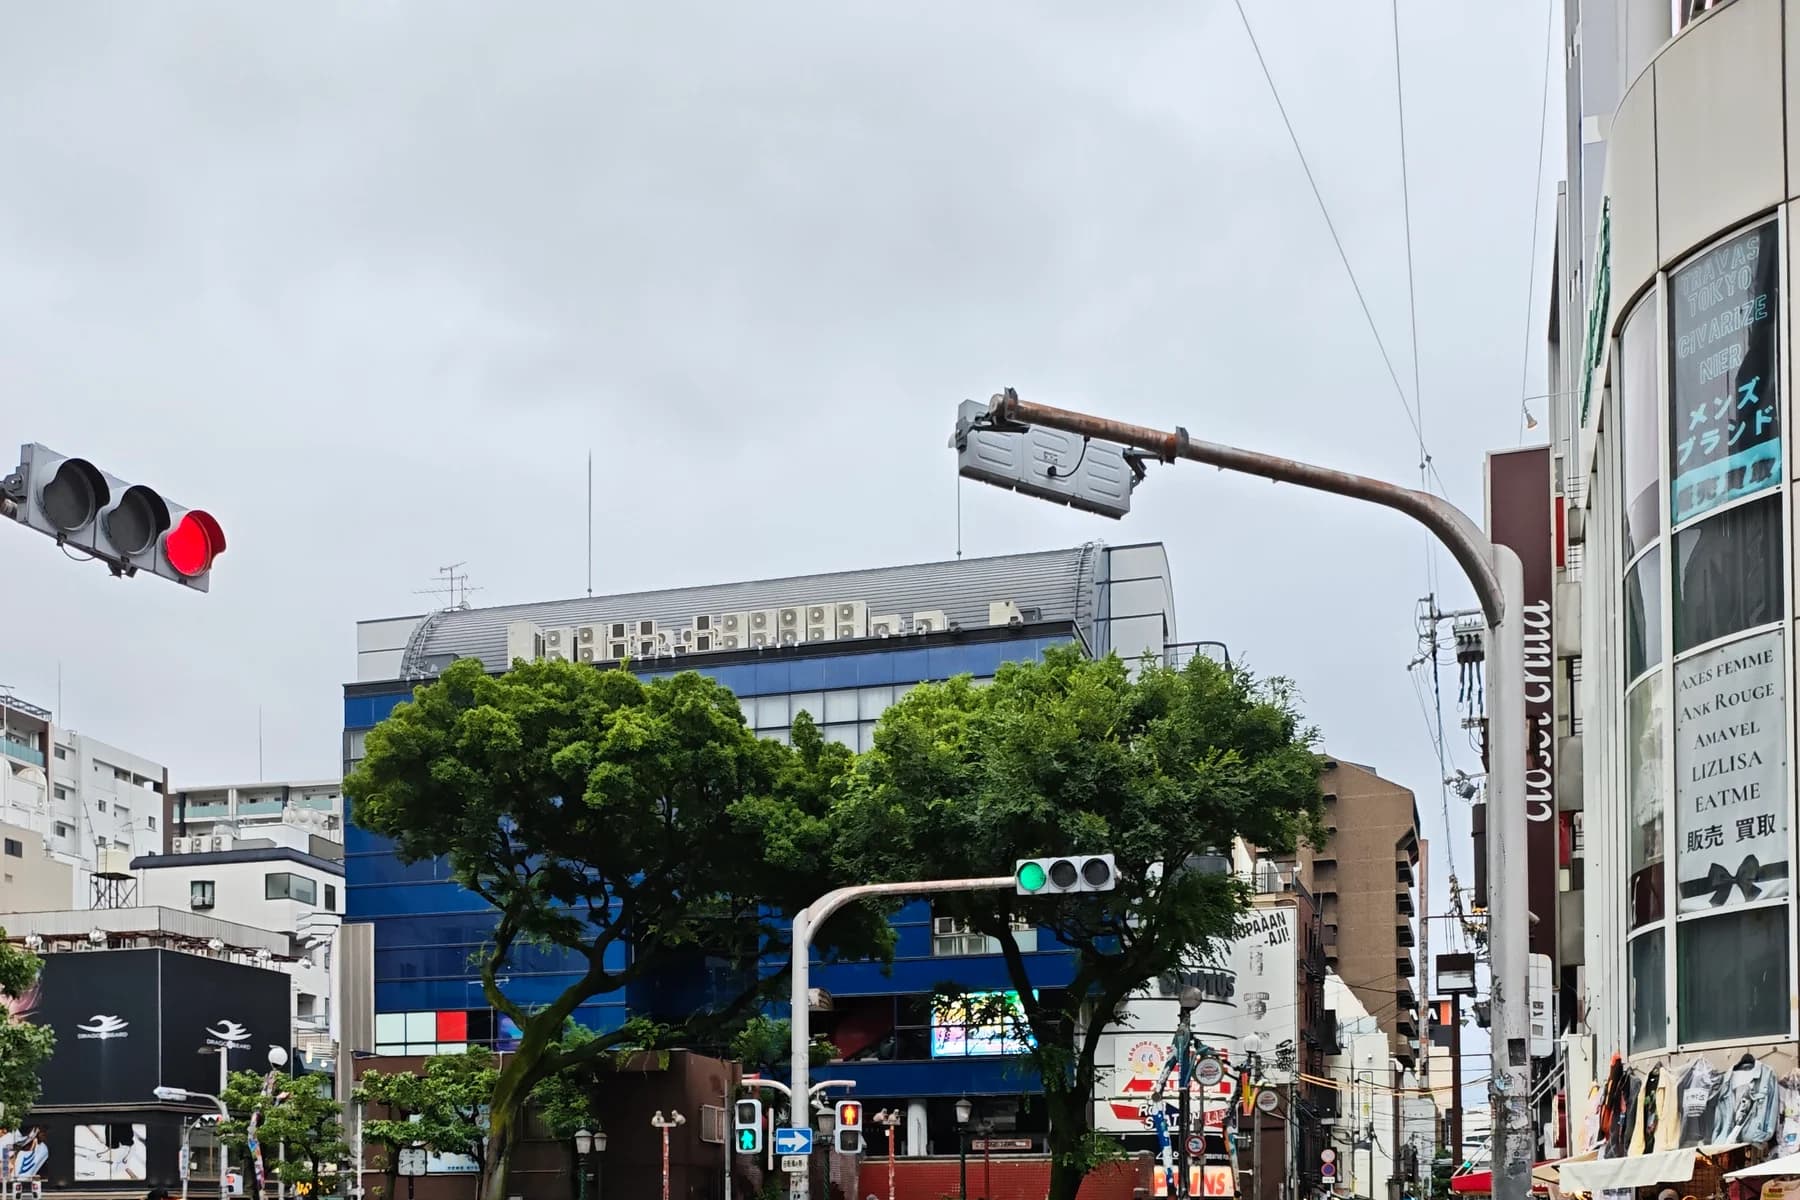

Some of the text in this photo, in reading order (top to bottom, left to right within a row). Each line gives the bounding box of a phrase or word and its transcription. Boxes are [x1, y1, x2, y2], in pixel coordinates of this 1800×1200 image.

[1681, 235, 1760, 297] TRAVAS
[1687, 265, 1752, 318] TOKYO
[1678, 294, 1768, 359] CIVARIZE
[1700, 343, 1742, 385] NIER
[1688, 375, 1761, 431] メンズ
[1678, 405, 1774, 466] ブランド
[1680, 649, 1775, 693] AXES FEMME
[1680, 683, 1775, 723] ANK ROUGE
[1693, 721, 1761, 750] AMAVEL
[1692, 750, 1763, 782] LIZLISA
[1695, 782, 1761, 813] EATME
[1687, 813, 1776, 854] 販売 買取
